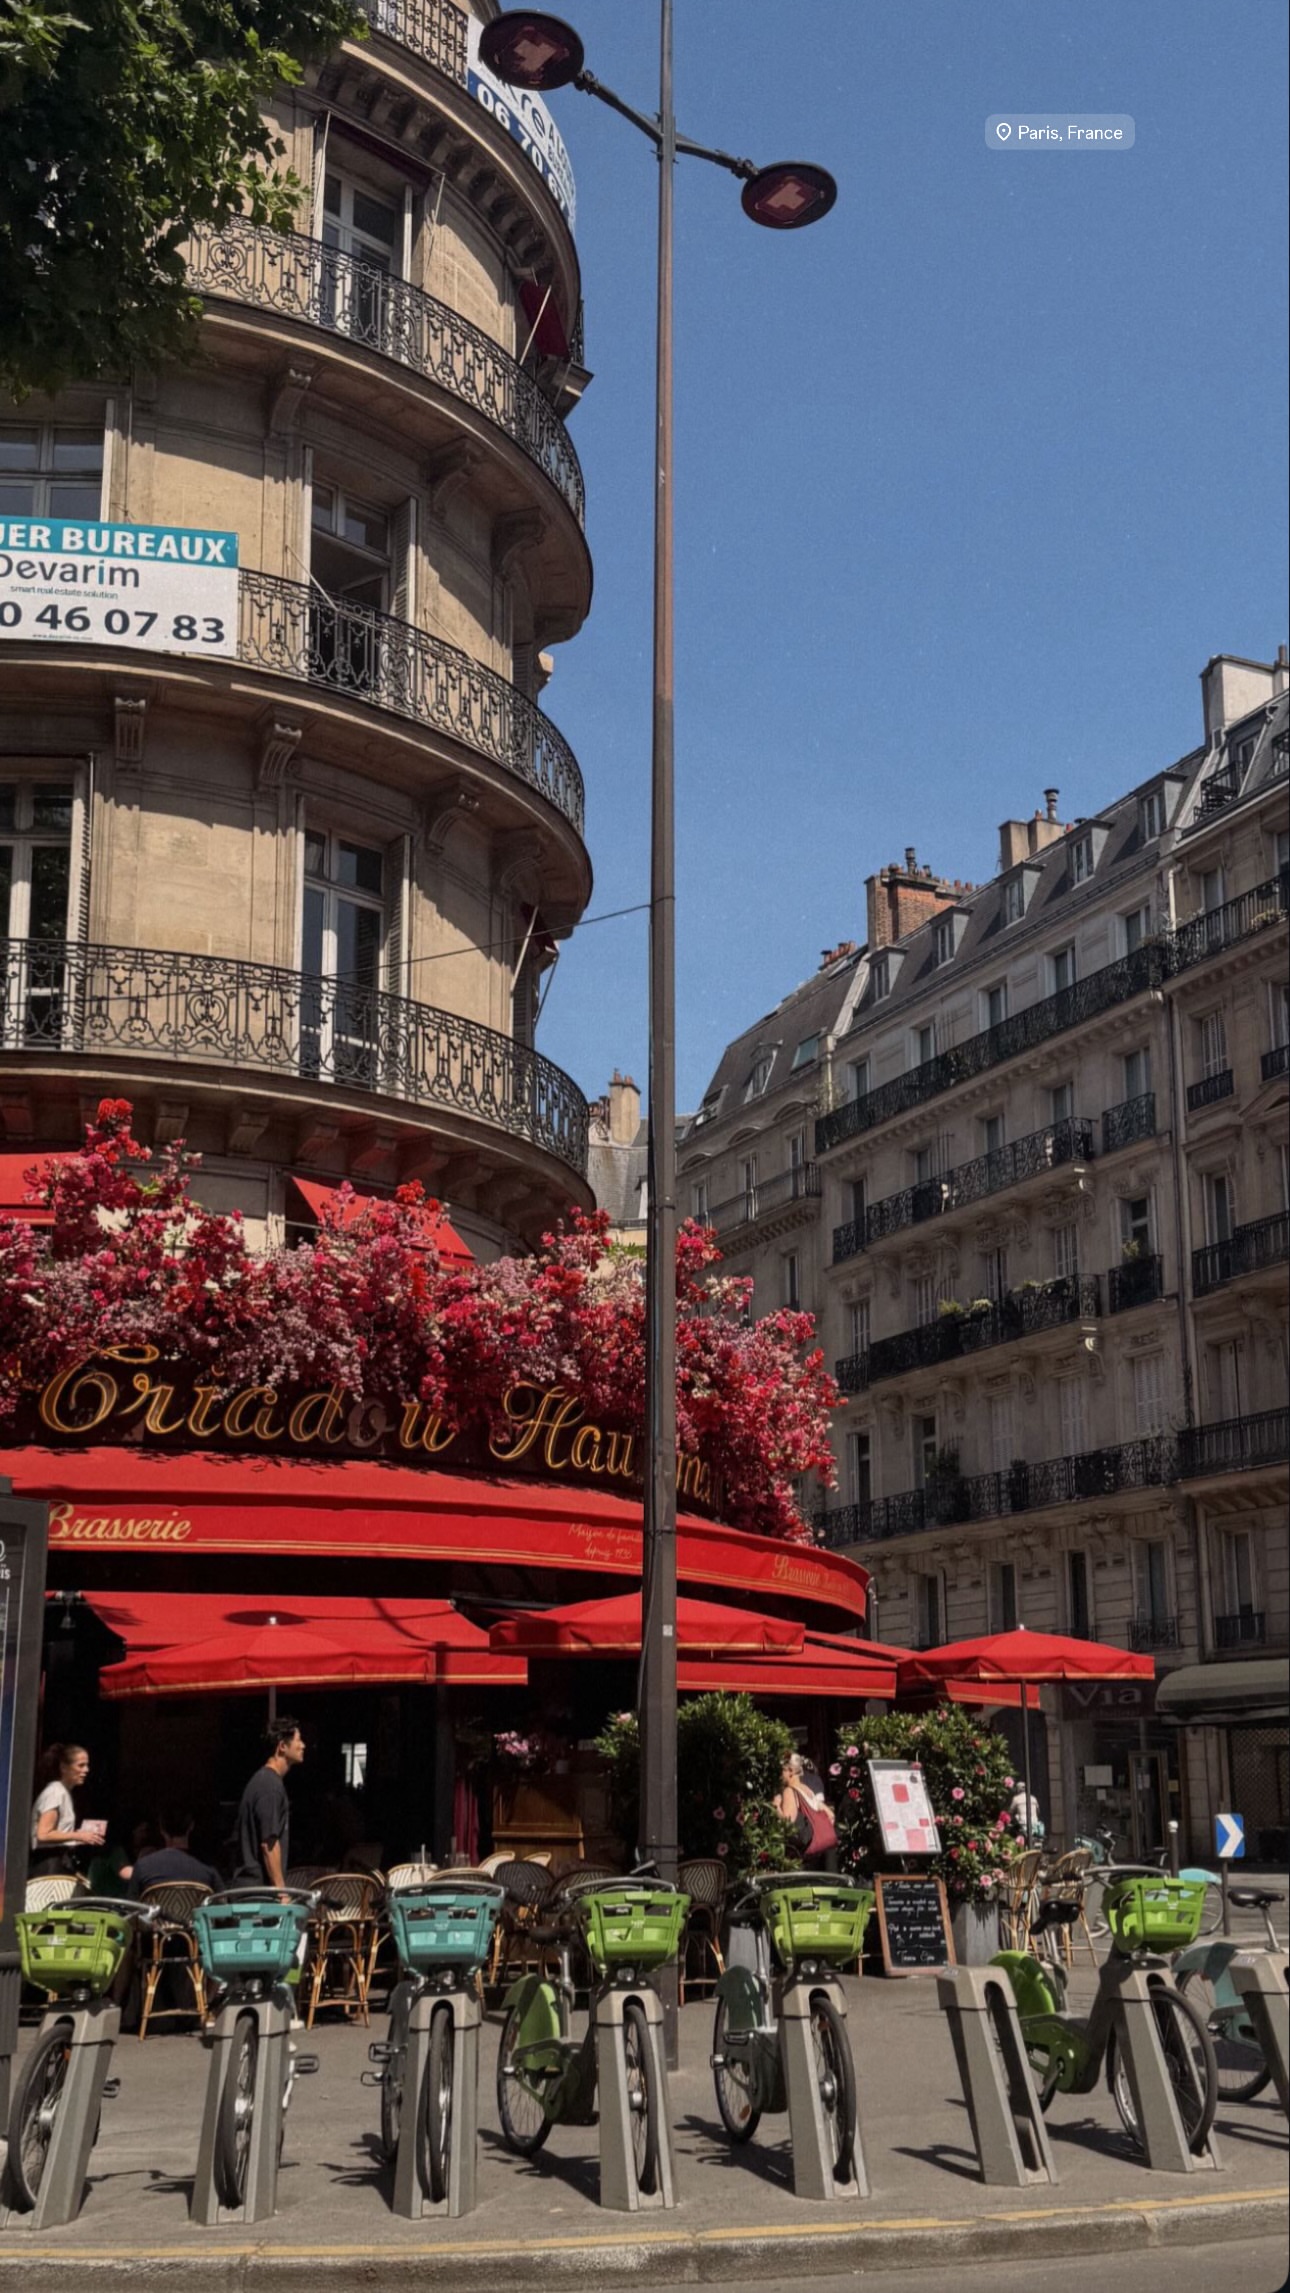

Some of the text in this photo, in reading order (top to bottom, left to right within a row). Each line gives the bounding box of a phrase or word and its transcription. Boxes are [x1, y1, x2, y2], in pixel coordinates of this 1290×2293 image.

[477, 83, 511, 131] 06
[62, 526, 227, 563] BUREAUX
[0, 553, 140, 588] Devarim
[10, 585, 119, 600] smart real estate solution
[35, 604, 91, 632] 46
[104, 608, 159, 637] 07
[172, 614, 226, 644] 83
[49, 1500, 192, 1541] Brasserie
[1068, 1683, 1142, 1707] Via
